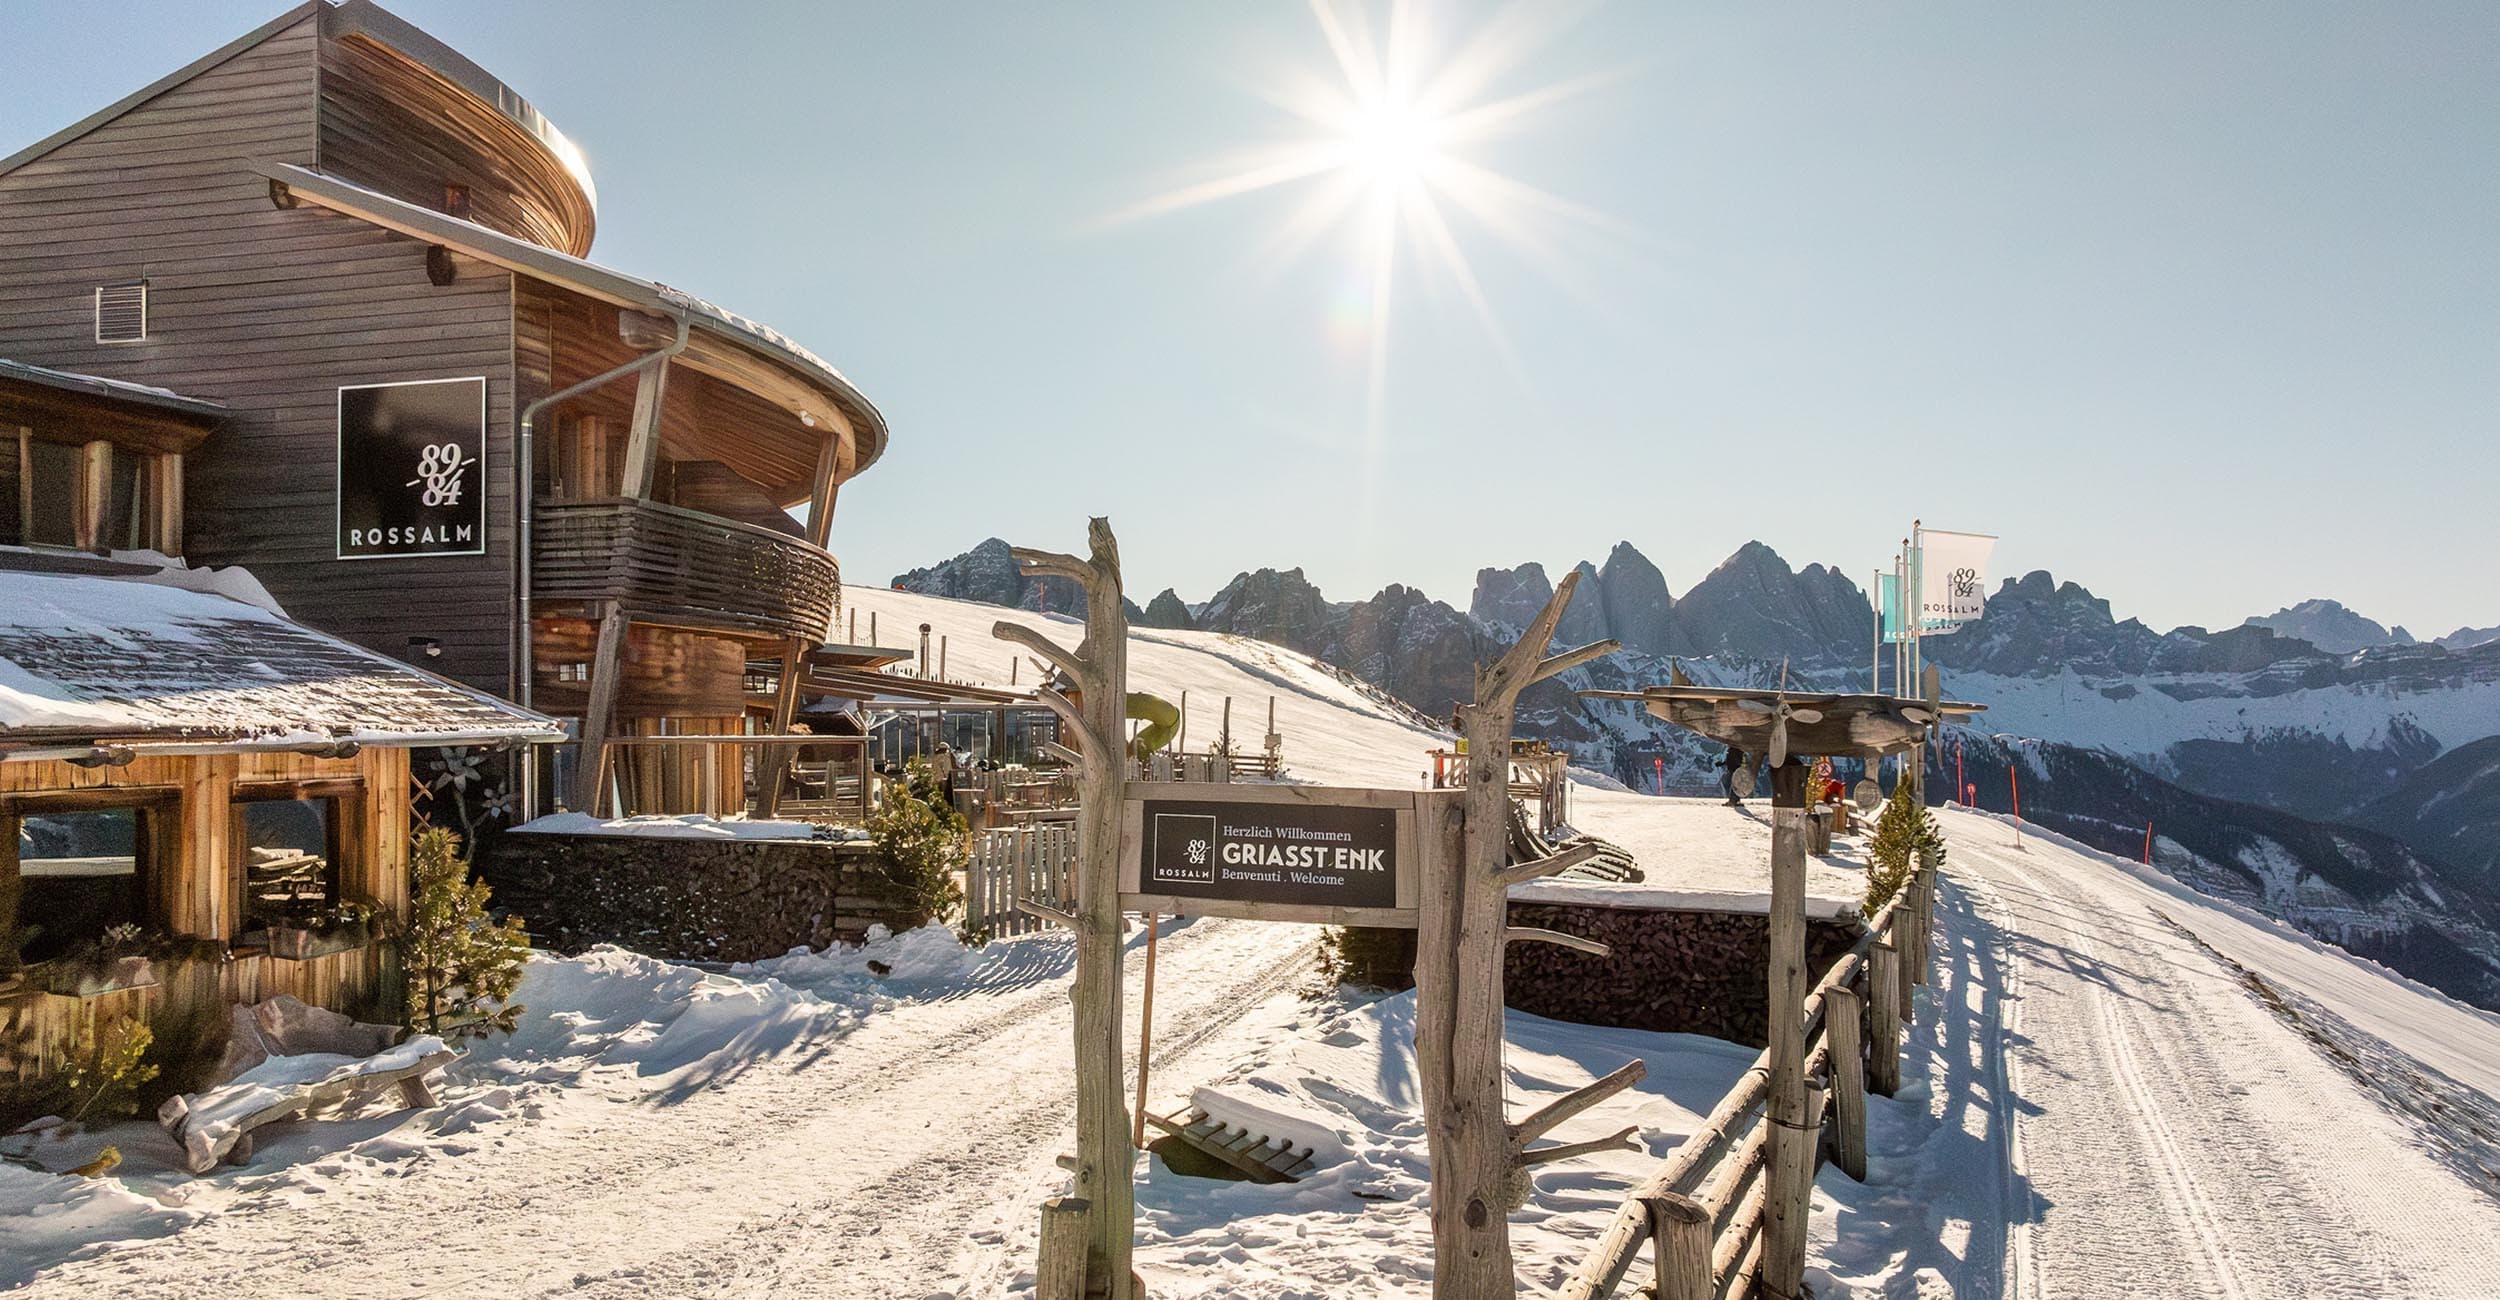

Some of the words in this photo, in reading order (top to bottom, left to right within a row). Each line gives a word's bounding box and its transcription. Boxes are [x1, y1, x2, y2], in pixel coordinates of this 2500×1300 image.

[417, 443, 462, 478] 89
[422, 468, 464, 506] 84
[351, 524, 472, 546] ROSSALM
[1953, 567, 1976, 584] 89
[1923, 603, 1980, 614] ROSSALM
[1223, 826, 1273, 838] Herzlich
[1275, 827, 1352, 842] Willkommen
[1187, 839, 1206, 853] 89
[1189, 851, 1207, 864] 84
[1222, 842, 1328, 868] GRIASST
[1335, 848, 1385, 871] ENK
[1159, 868, 1209, 878] ROSSALM
[1222, 869, 1281, 882] Benvenuti
[1290, 871, 1345, 885] Welcome
